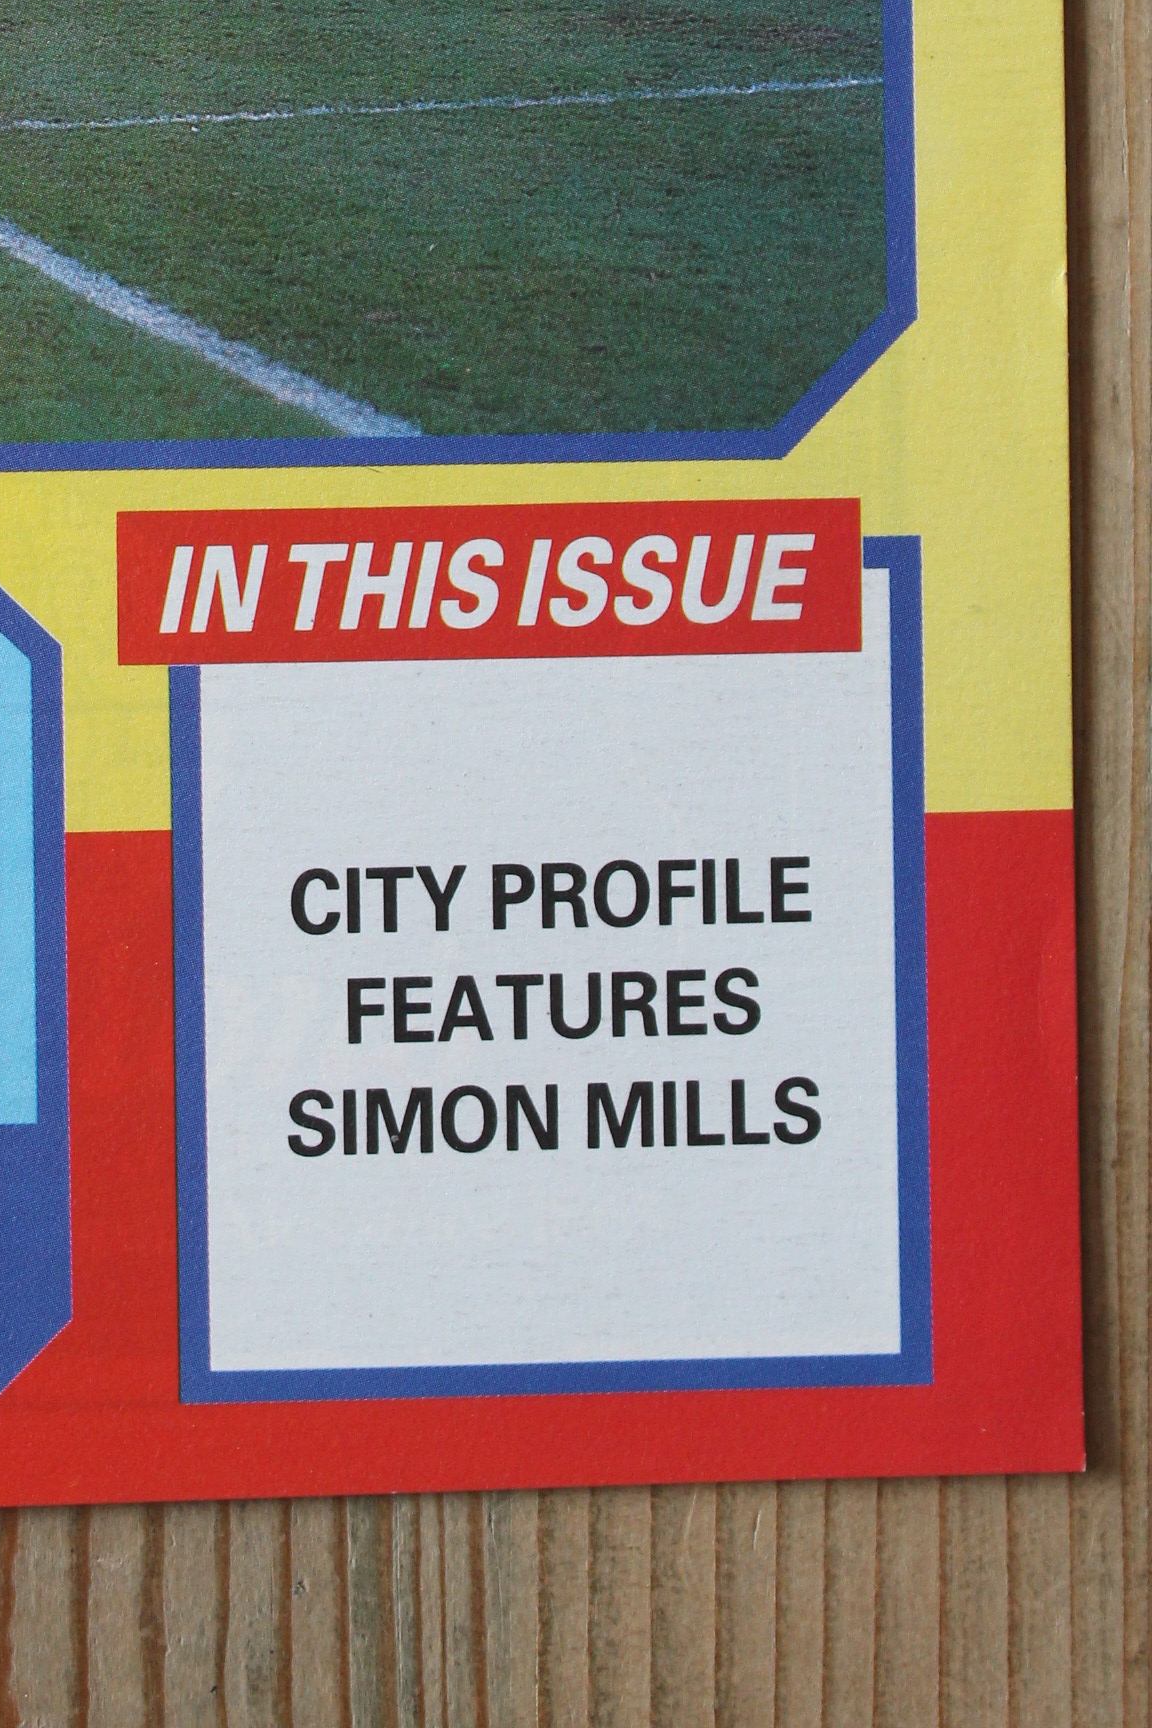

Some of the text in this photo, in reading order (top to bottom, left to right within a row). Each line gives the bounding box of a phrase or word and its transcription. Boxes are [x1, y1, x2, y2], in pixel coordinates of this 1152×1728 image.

[158, 533, 816, 634] IN THIS ISSUE
[290, 856, 813, 934] CITY PROFILE
[345, 967, 762, 1044] FEATURES
[286, 1076, 822, 1157] SIMON MILLS
